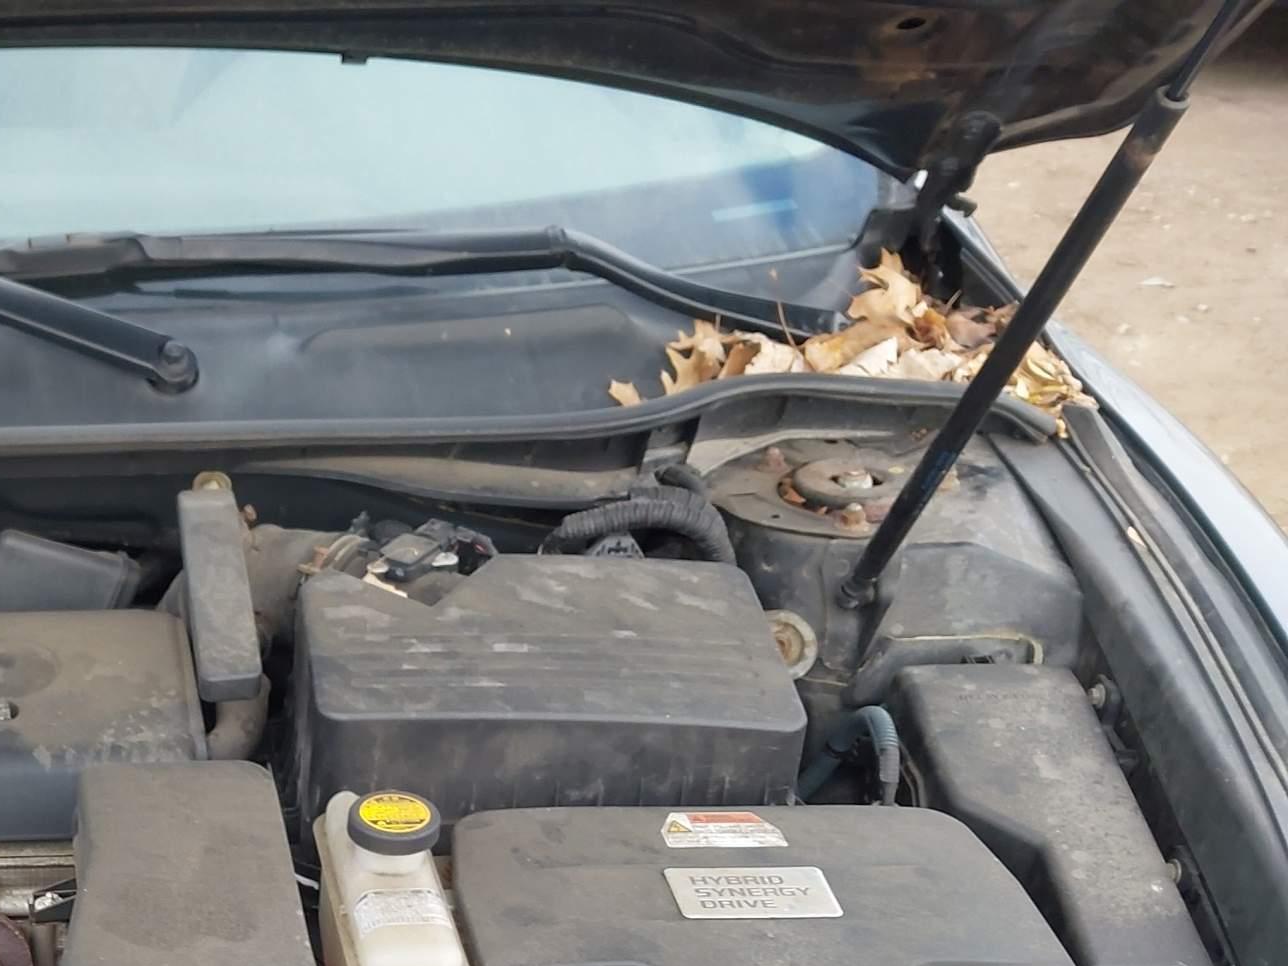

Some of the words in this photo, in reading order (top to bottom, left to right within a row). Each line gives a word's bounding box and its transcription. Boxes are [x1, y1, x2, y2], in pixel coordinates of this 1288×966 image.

[689, 876, 784, 886] HYBRID
[695, 887, 810, 898] SYNERGY
[701, 899, 777, 909] DRIVE
